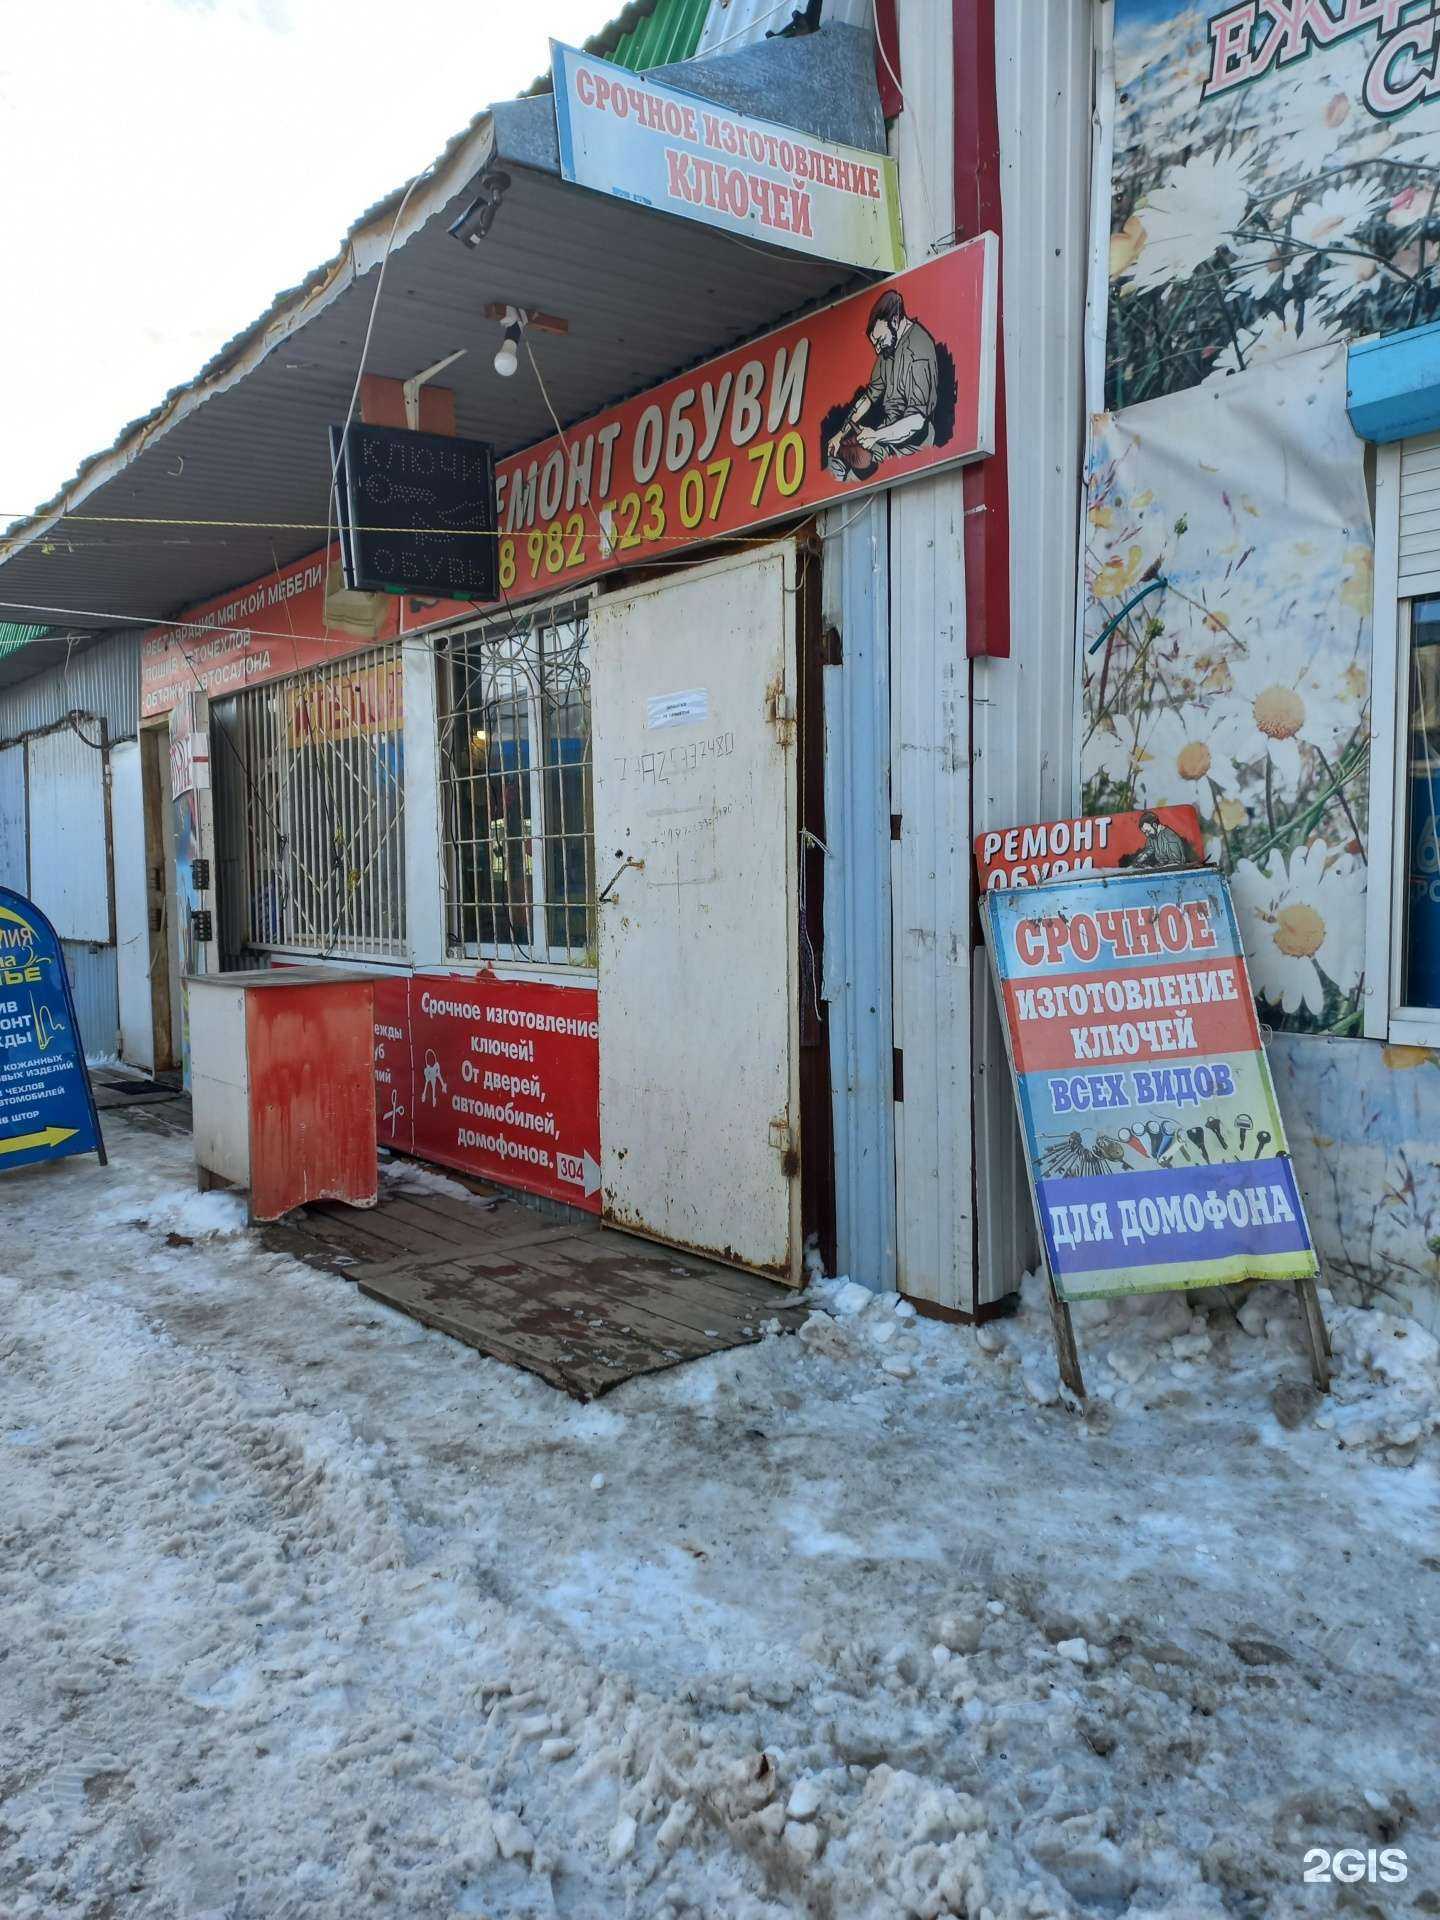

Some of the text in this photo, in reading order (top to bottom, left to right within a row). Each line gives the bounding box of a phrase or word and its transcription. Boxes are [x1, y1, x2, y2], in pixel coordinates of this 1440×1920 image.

[576, 68, 881, 198] СРОЧНОЕ ИЗГОТОВЛЕНИЕ
[665, 149, 813, 238] КЛЮЧЕЙ
[632, 337, 810, 484] ОБУВИ
[499, 539, 517, 589] 8
[527, 513, 586, 579] 982
[678, 457, 731, 529] 07
[748, 431, 805, 507] 70
[373, 548, 486, 585] ОБУВЬ
[217, 585, 265, 626] МЯГКОЙ
[268, 564, 323, 606] МЕБЕЛИ
[983, 816, 1112, 865] РЕМОНТ
[1015, 900, 1216, 967] СРОЧНОЕ
[421, 991, 598, 1040] Срочное изготовление
[1015, 968, 1239, 1020] ИЗГОТОВЛЕНИЕ
[471, 1035, 534, 1063] ключей!
[1070, 1009, 1198, 1060] КЛЮЧЕЙ
[3, 1054, 63, 1072] КОЖАННЫХ
[26, 1060, 74, 1078] ИЗДЕЛИЙ
[461, 1060, 546, 1103] От дверей,
[5, 1082, 45, 1096] ЧЕХЛОВ
[1050, 1063, 1235, 1113] ВСЕХ ВИДОВ
[11, 1110, 40, 1122] ШТОР
[452, 1095, 561, 1141] автомобилей,
[457, 1128, 554, 1169] домофонов.
[560, 1157, 584, 1181] 304
[1048, 1184, 1296, 1252] ДЛЯ ДОМОФОНА
